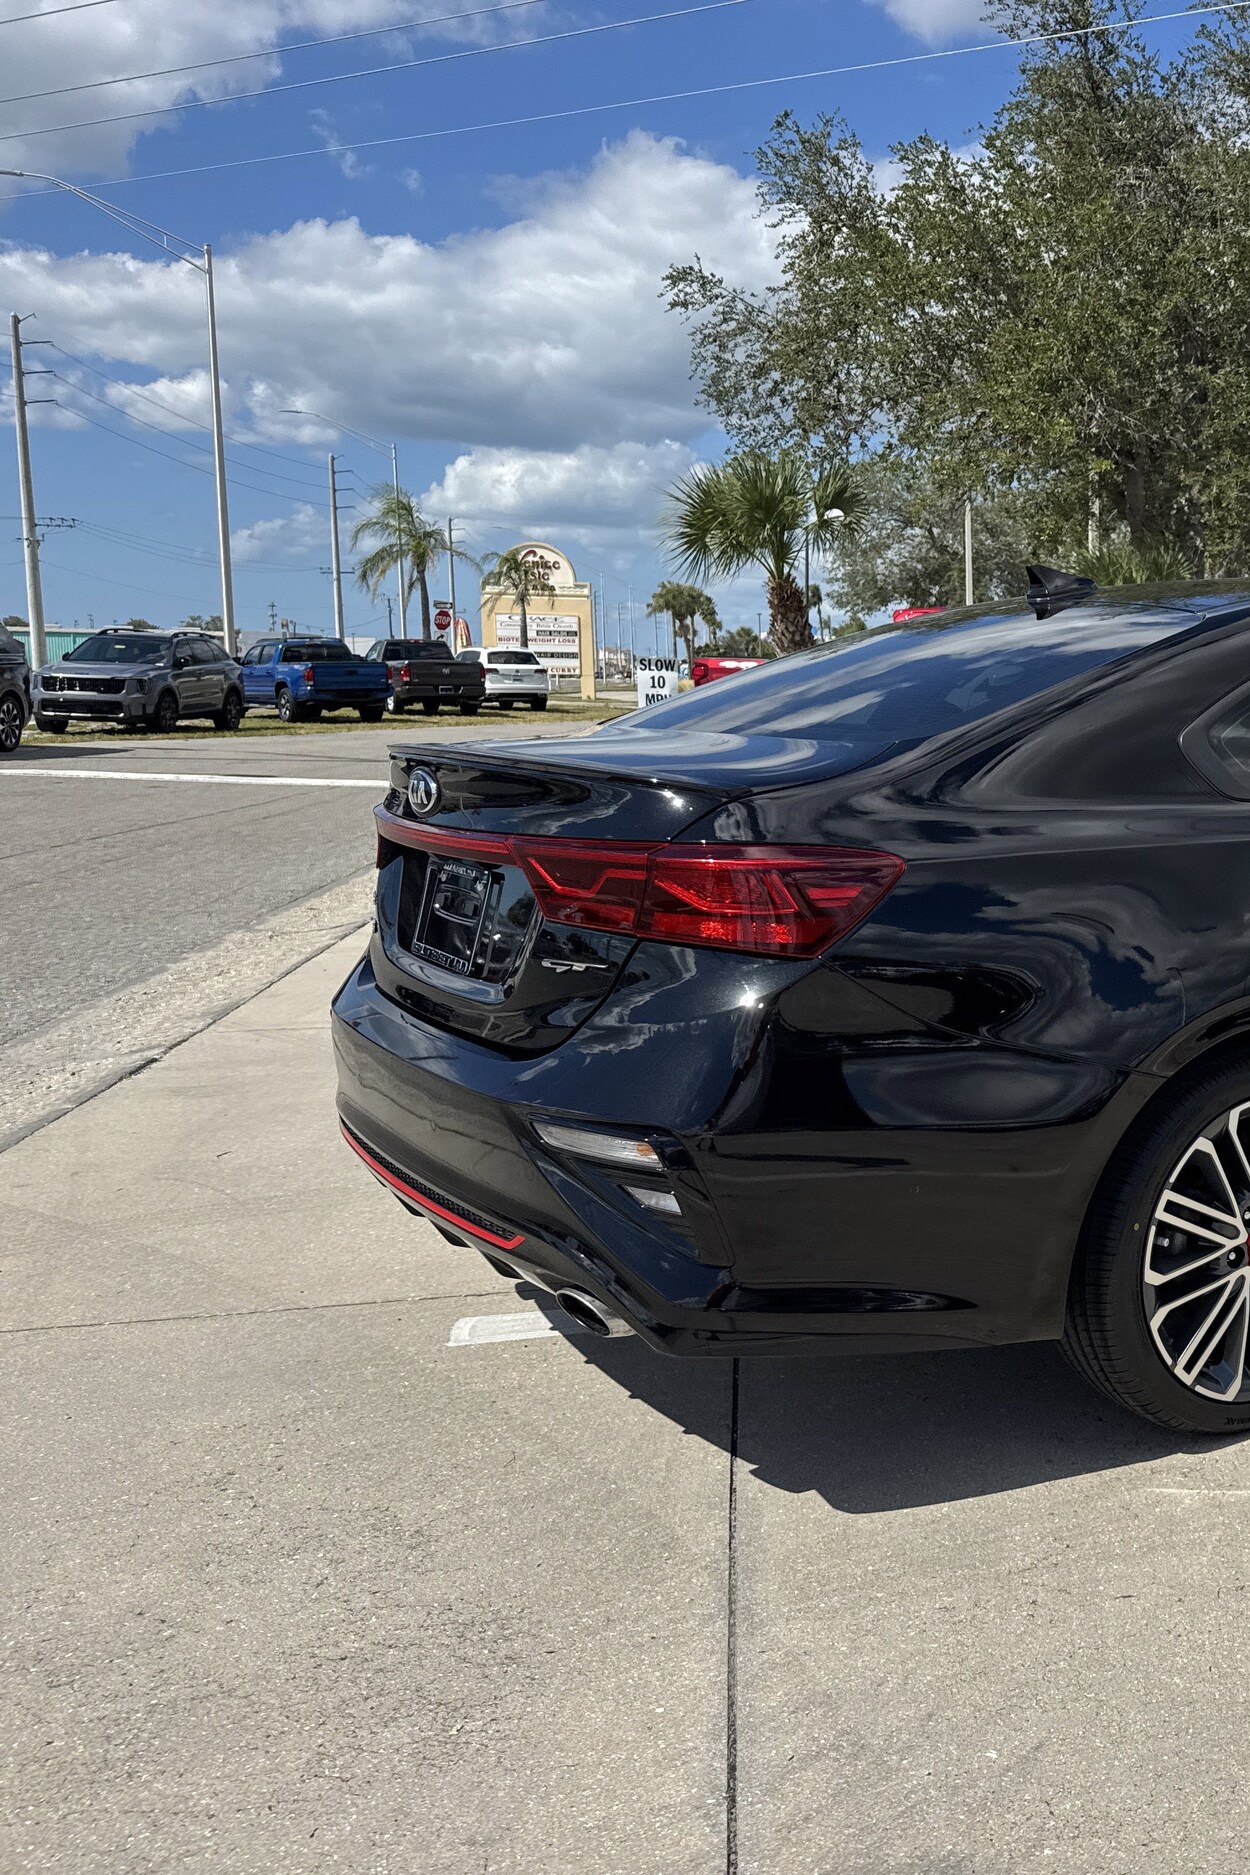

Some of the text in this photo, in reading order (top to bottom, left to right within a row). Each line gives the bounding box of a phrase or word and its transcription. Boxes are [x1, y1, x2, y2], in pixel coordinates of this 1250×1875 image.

[435, 615, 451, 625] STOP
[639, 658, 676, 671] SLOW
[650, 675, 666, 689] 10
[645, 693, 672, 706] MP
[541, 958, 609, 973] GT
